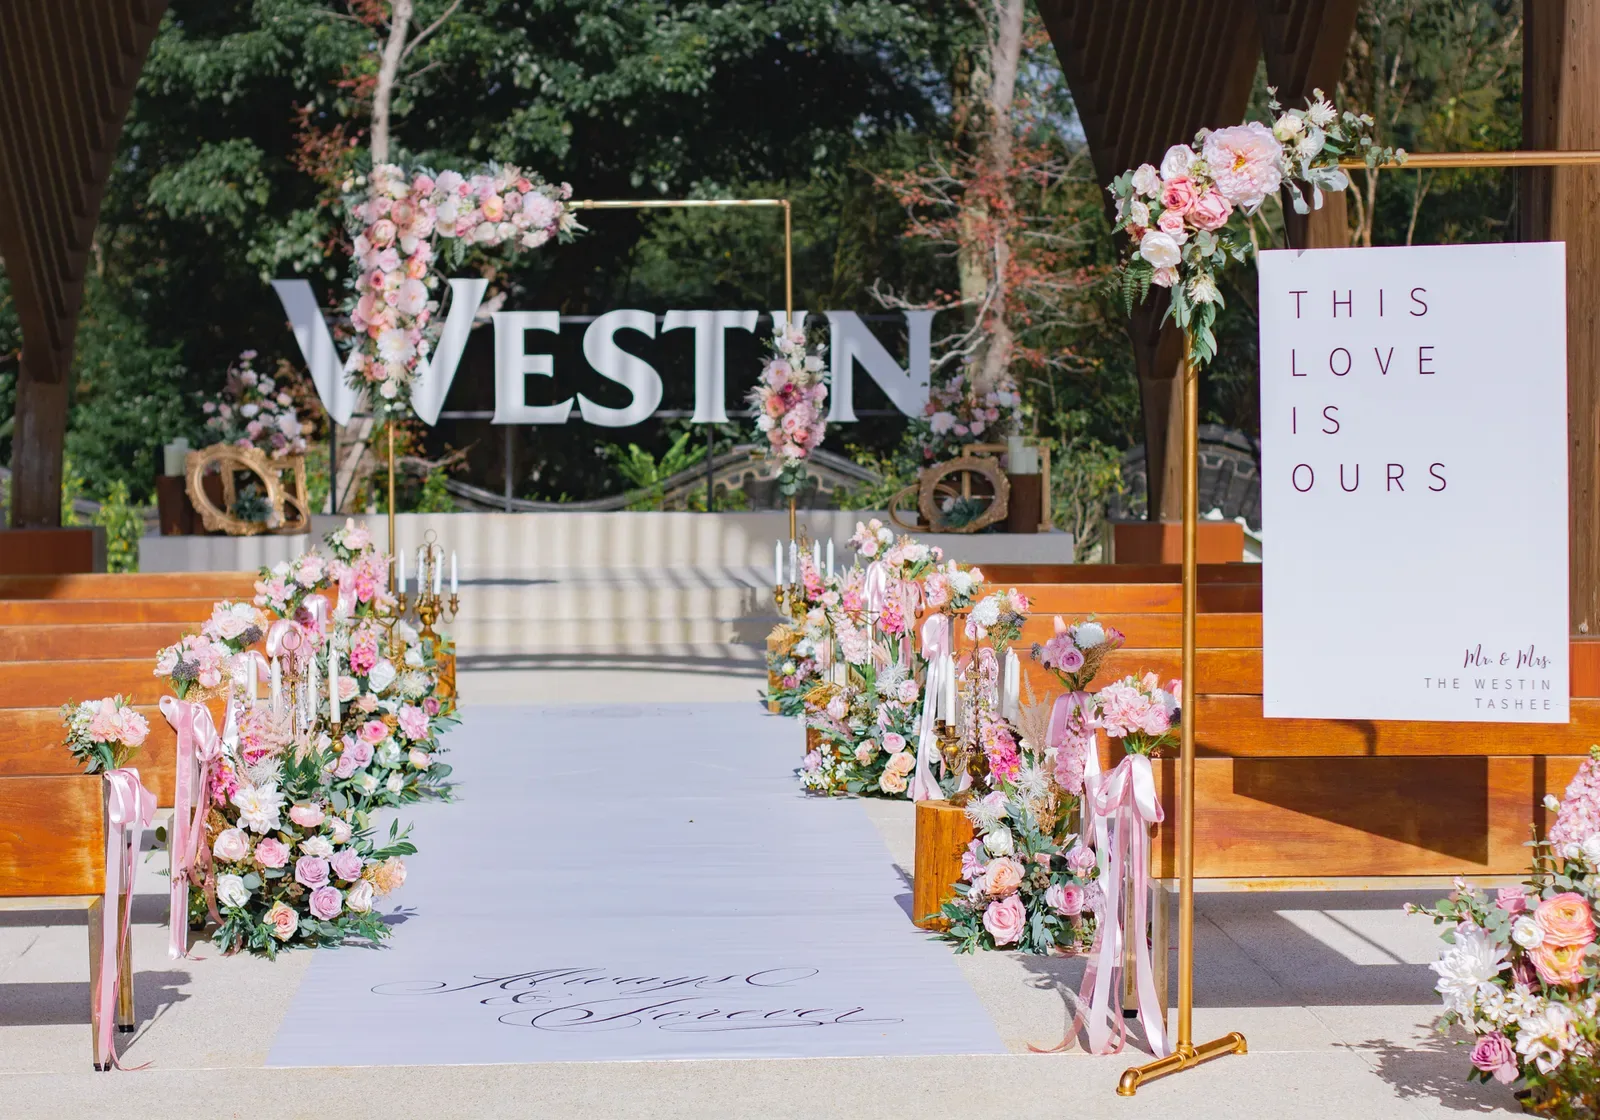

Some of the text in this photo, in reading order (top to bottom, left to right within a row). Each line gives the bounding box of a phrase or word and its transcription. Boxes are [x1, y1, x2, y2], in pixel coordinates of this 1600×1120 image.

[1288, 286, 1429, 320] THIS
[271, 277, 936, 427] WESTN
[1291, 345, 1437, 378] LOVE
[1291, 405, 1342, 436] IS
[1291, 462, 1448, 493] OURS
[1463, 643, 1552, 670] Mr. & Mrs.
[1423, 677, 1551, 691] THE WESTIN
[1474, 697, 1552, 711] TASHEE
[371, 967, 820, 995] Always
[498, 995, 905, 1032] Forever
